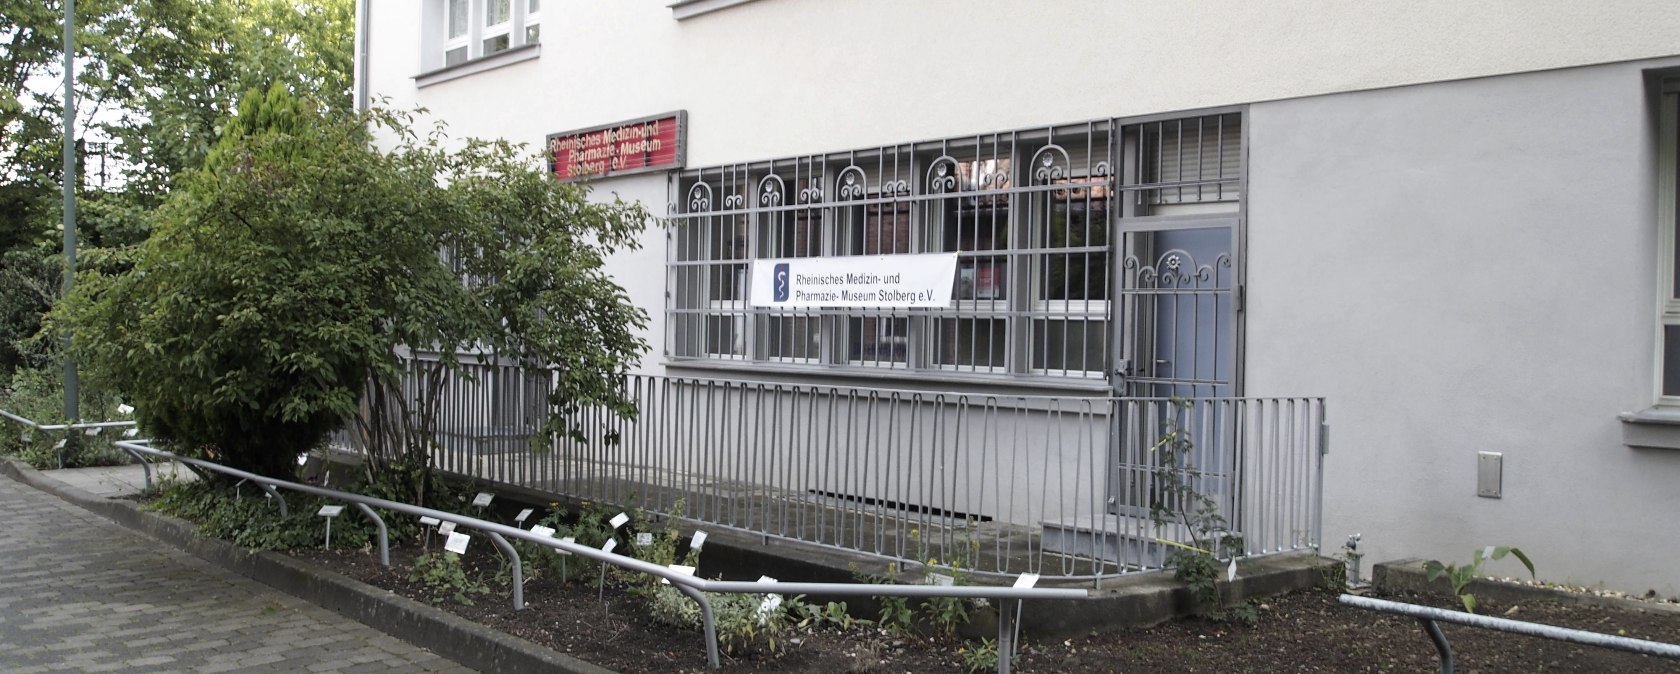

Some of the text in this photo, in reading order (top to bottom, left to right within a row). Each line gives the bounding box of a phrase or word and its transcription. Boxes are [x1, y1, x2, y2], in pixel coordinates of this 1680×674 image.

[550, 133, 601, 153] Rheinisches
[620, 138, 661, 156] Museum
[567, 160, 605, 177] Stolberg
[796, 272, 901, 286] Rheinisches Medizin- und
[796, 289, 935, 304] Pharmazie- Museum Stolberg e.V.
